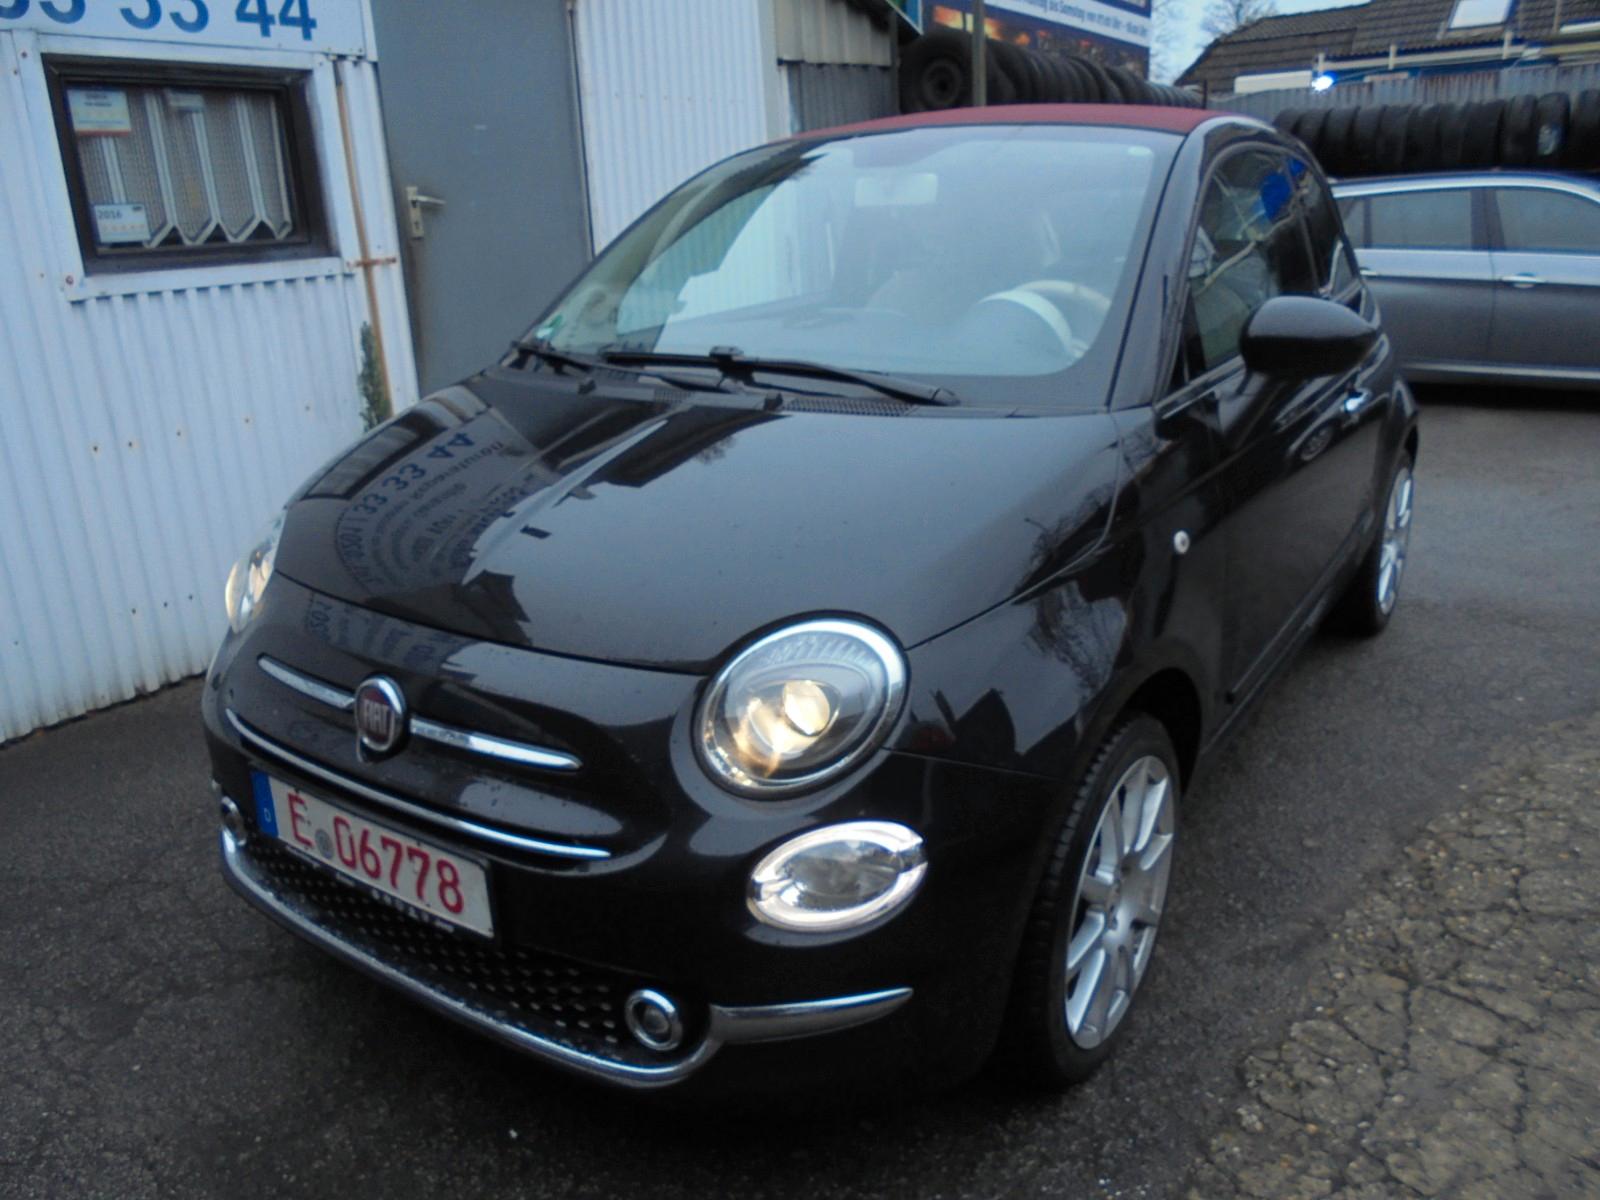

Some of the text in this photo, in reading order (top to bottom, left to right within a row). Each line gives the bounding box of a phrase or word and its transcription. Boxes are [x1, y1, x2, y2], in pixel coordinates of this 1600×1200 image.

[363, 699, 390, 734] FIAT
[287, 792, 314, 848] E
[332, 815, 465, 915] 06778
